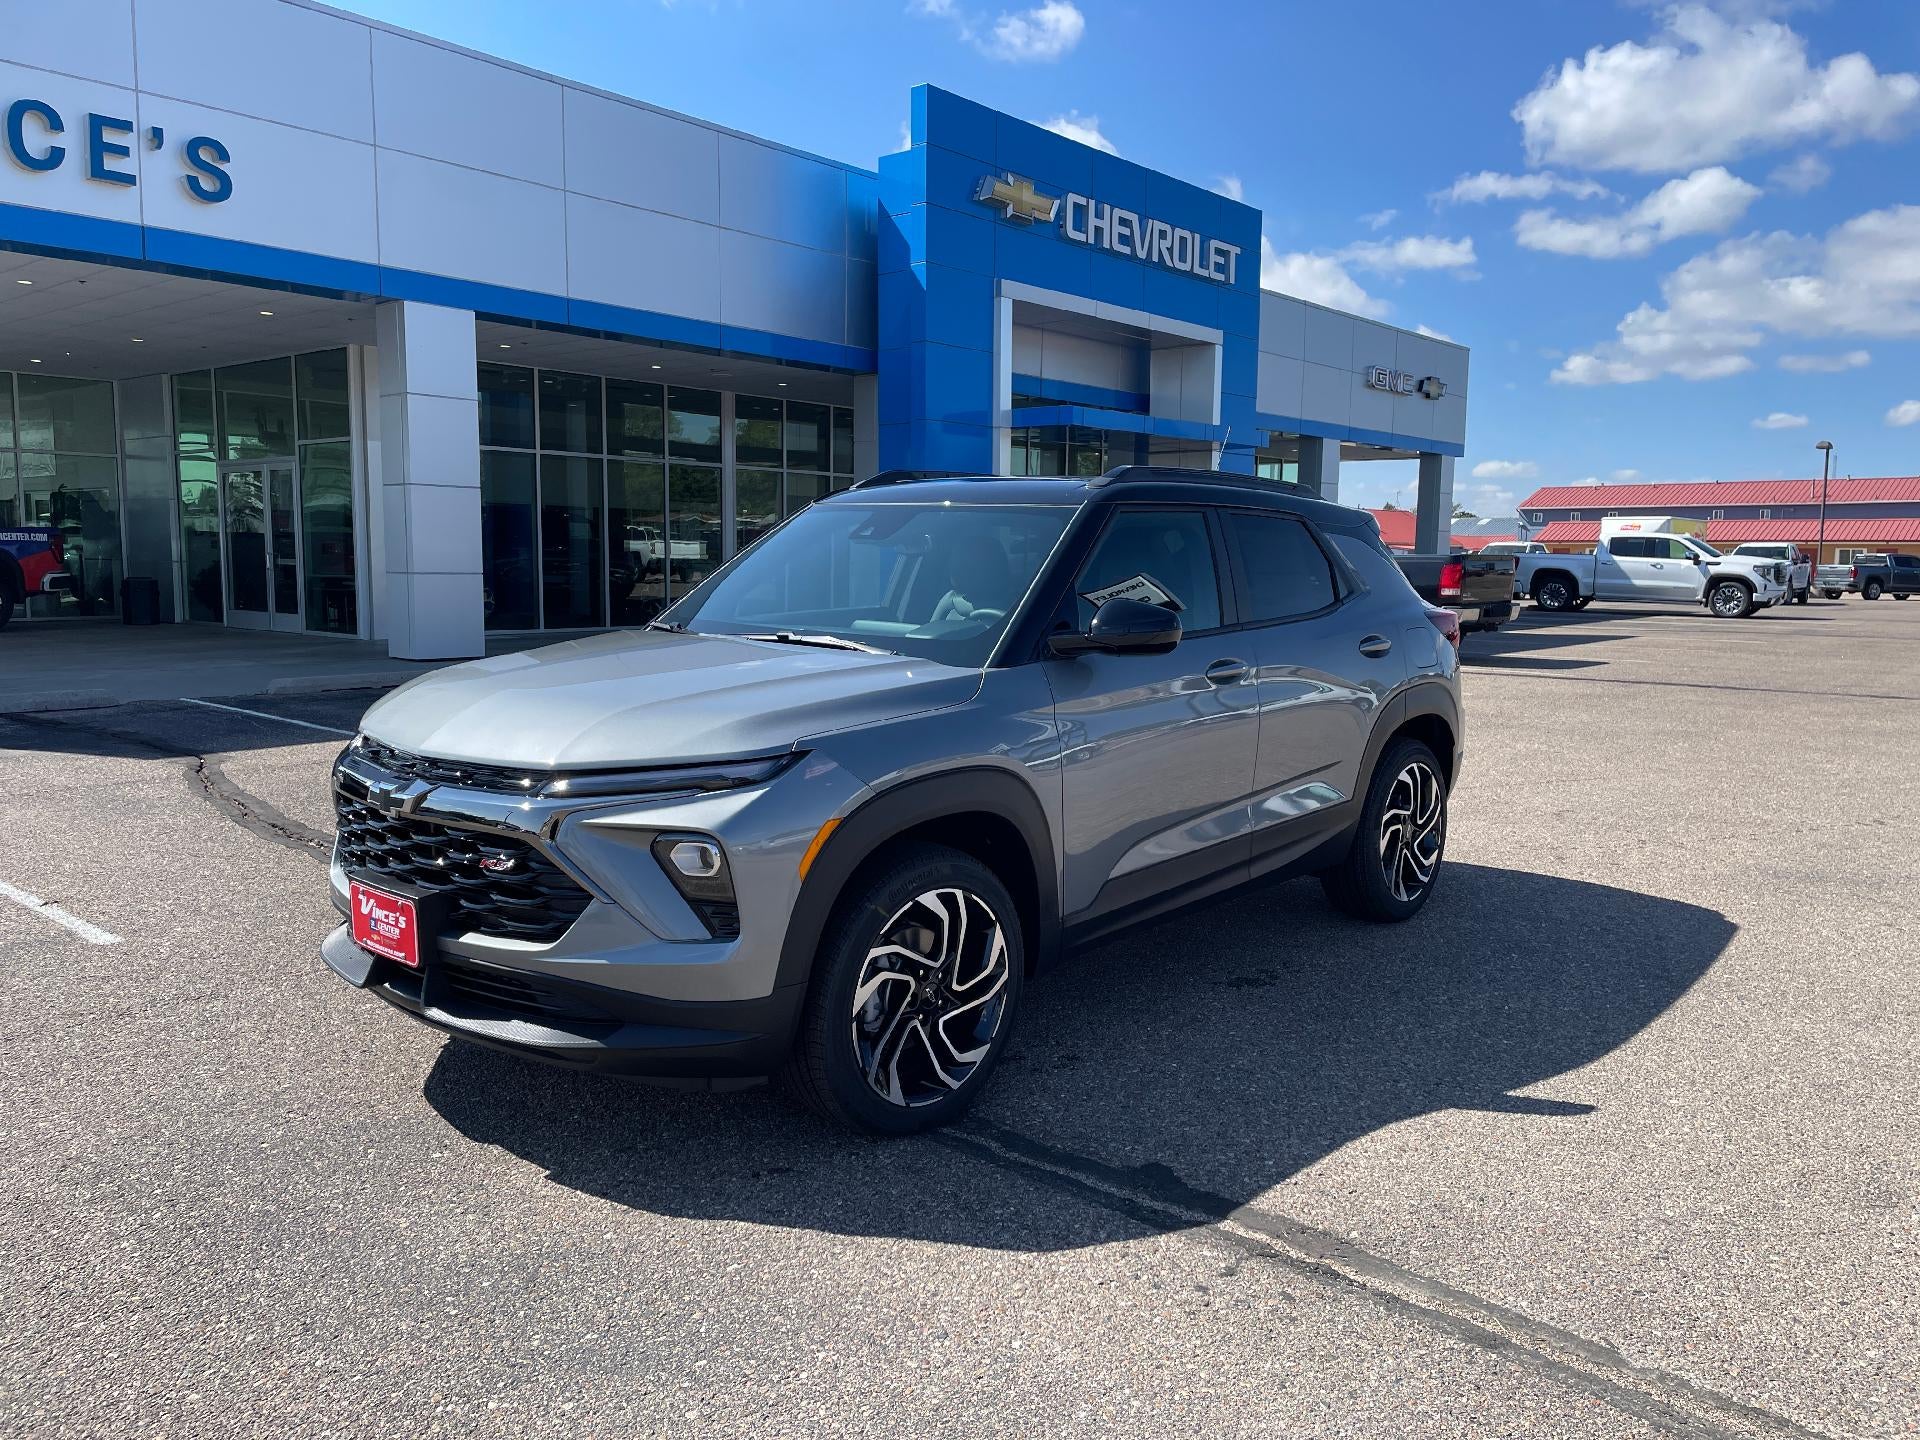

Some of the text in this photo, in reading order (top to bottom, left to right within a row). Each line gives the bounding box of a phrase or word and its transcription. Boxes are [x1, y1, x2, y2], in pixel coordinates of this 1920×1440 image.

[6, 99, 233, 203] CE'S
[1063, 192, 1241, 284] CHEVROLET
[1371, 366, 1415, 396] GMC
[377, 922, 400, 936] CENTER
